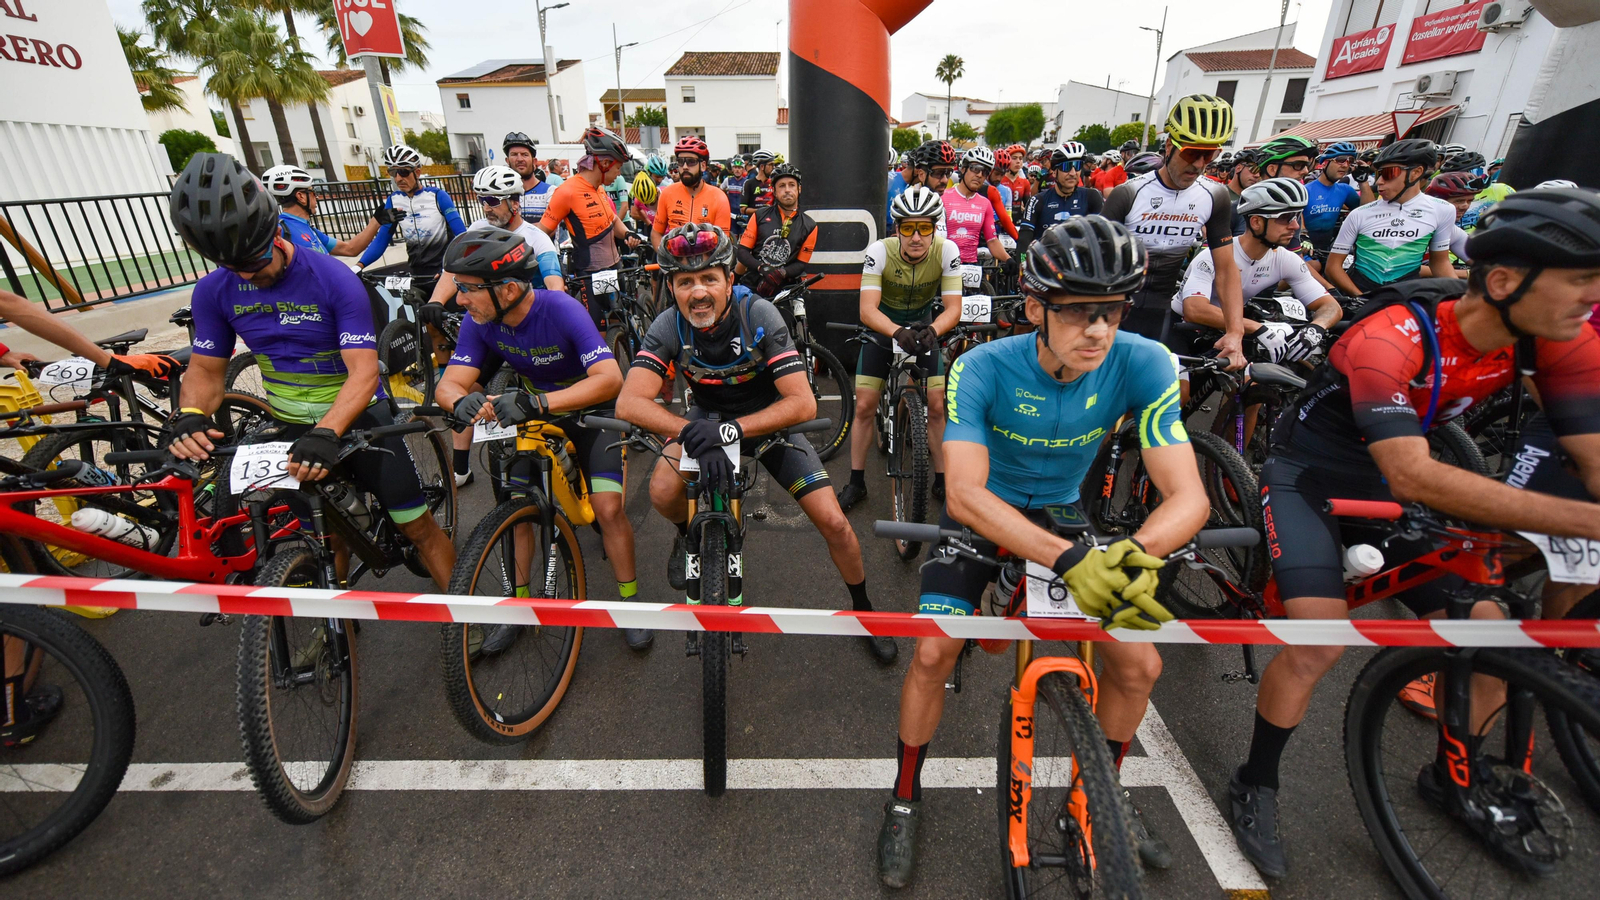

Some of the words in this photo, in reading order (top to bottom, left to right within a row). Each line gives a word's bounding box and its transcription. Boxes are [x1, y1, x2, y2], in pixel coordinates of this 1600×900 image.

[1411, 26, 1445, 42] Castellar
[948, 209, 983, 224] Agerul
[1141, 212, 1199, 223] Tikismikis
[1135, 225, 1195, 237] WICO
[1372, 228, 1420, 238] alfasol
[491, 242, 527, 271] MET
[276, 301, 319, 313] Bikes
[962, 303, 989, 316] 305
[1282, 302, 1305, 317] 346
[529, 344, 560, 357] Bikes
[46, 364, 89, 381] 269
[947, 357, 965, 425] MAVIC
[1013, 406, 1041, 418] OAKLEY
[1506, 444, 1551, 490] Ageru
[1264, 505, 1282, 559] ESPEJO
[545, 551, 558, 596] ROCKSHOX
[1009, 779, 1024, 824] FOX
